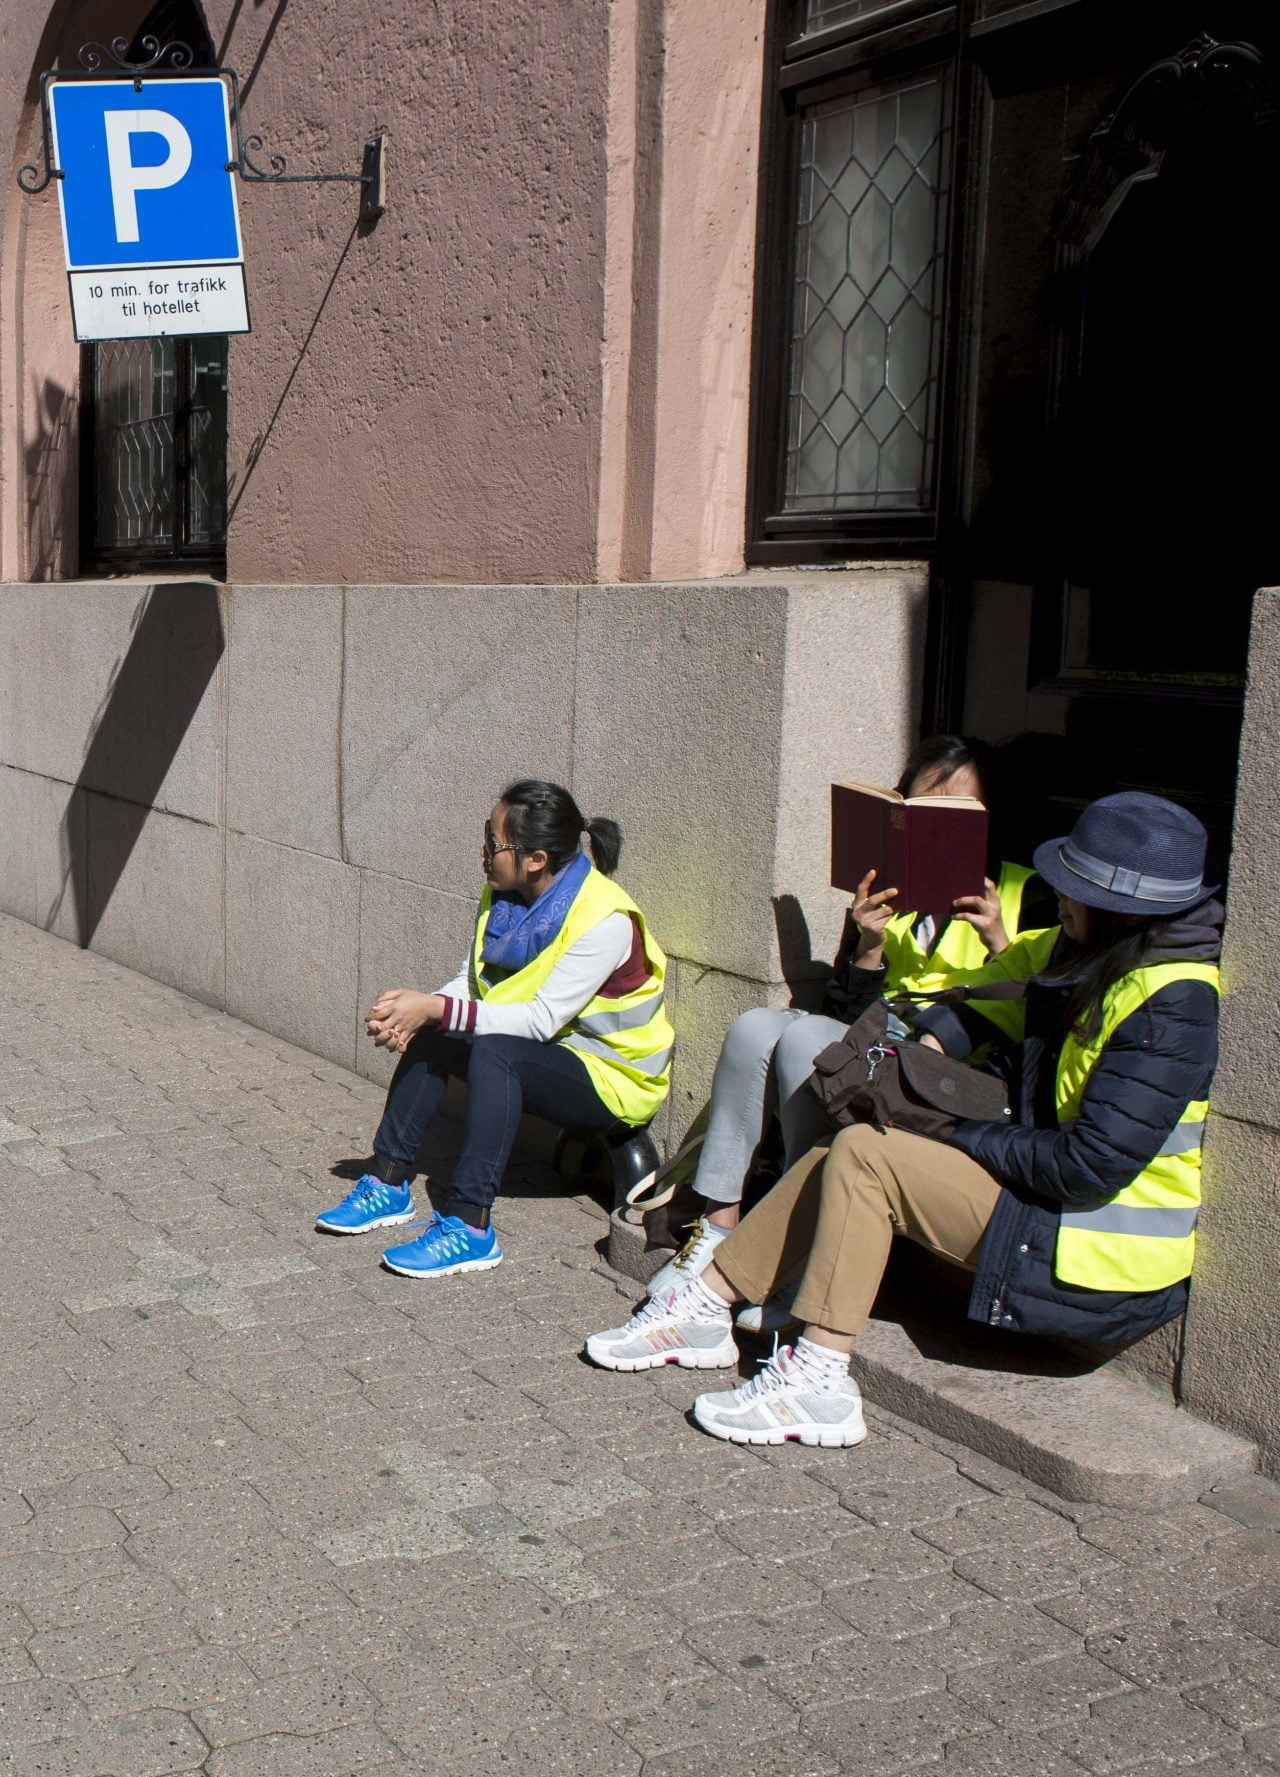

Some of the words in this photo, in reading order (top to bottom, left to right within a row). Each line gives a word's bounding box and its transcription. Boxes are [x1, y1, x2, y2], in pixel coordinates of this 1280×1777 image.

[103, 109, 193, 244] P
[88, 285, 104, 299] 10
[110, 282, 142, 297] min.
[148, 279, 170, 295] for
[177, 277, 227, 293] trafikk
[121, 301, 137, 317] til
[143, 298, 200, 315] hotellet
